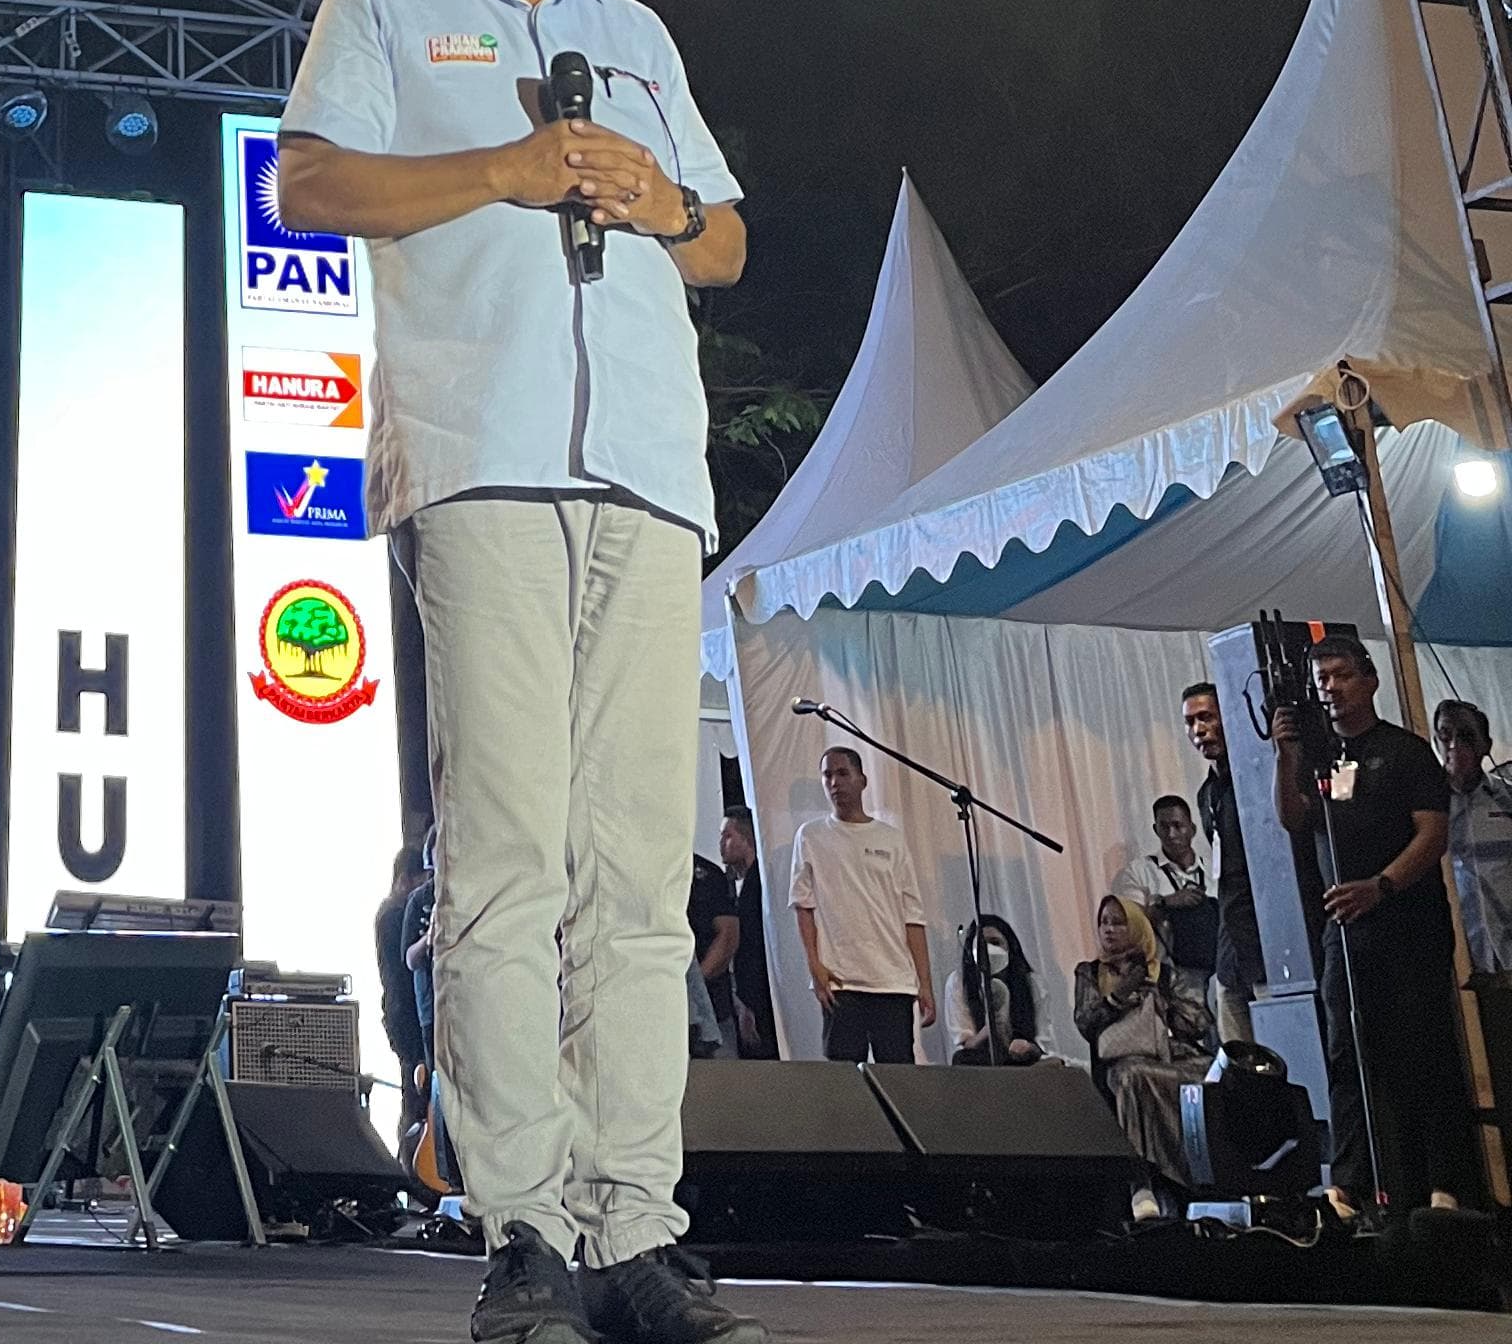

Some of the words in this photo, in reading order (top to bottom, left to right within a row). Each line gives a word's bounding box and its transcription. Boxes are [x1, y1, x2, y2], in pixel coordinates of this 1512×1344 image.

[246, 250, 351, 297] PAN
[252, 374, 341, 399] HANURA
[308, 506, 347, 521] PRIMA
